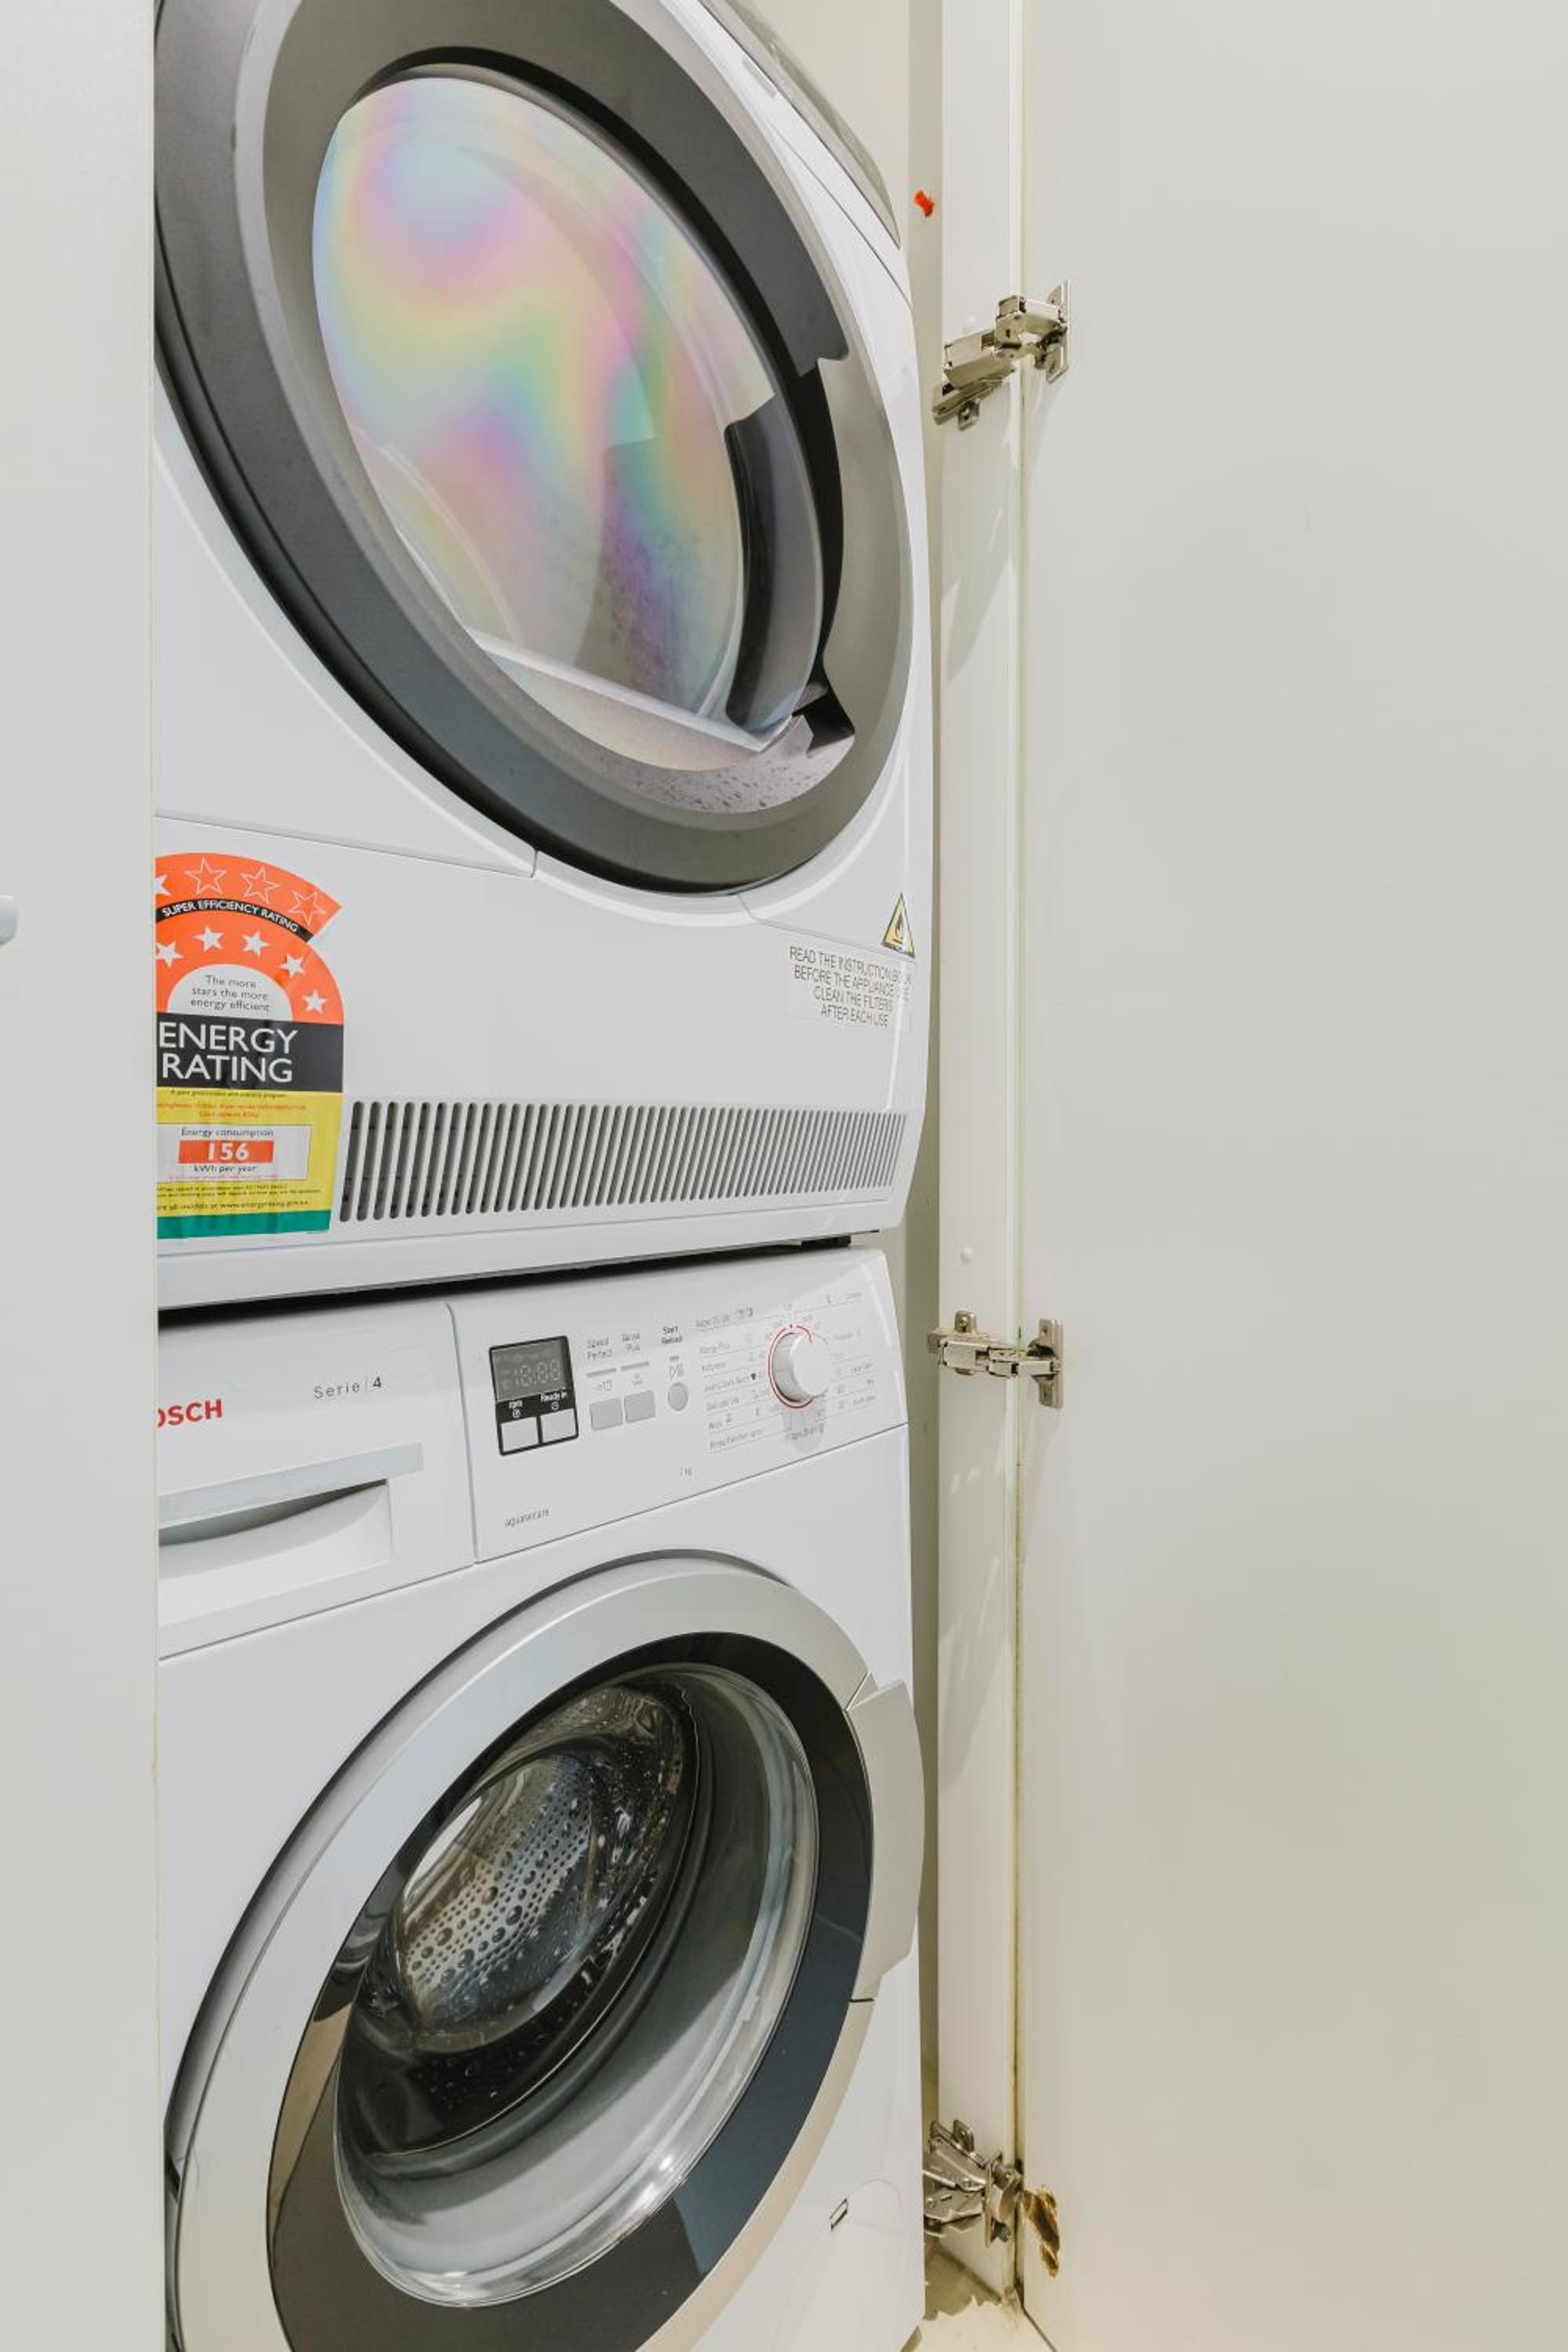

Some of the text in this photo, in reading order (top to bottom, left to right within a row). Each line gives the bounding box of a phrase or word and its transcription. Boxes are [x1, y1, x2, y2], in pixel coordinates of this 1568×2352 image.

[162, 899, 299, 933] SUPER EFFICIENCY RATING
[789, 946, 816, 964] READ
[818, 951, 837, 969] THE
[206, 975, 256, 989] The more
[794, 964, 832, 985] BEFORE
[833, 971, 851, 989] THE
[192, 987, 268, 1001] stars the more
[814, 985, 893, 1012] CLEAN THE FILTERS
[191, 1000, 270, 1012] energy efficient
[821, 1004, 849, 1021] AFTER
[851, 1007, 872, 1024] EACH
[159, 1022, 298, 1054] ENERGY
[162, 1053, 292, 1083] RATING
[181, 1127, 274, 1138] Energy consumption
[208, 1142, 250, 1162] 156
[220, 1166, 234, 1174] per
[238, 1166, 257, 1174] year
[314, 1376, 383, 1399] Serie 4
[158, 1399, 223, 1428] SCH
